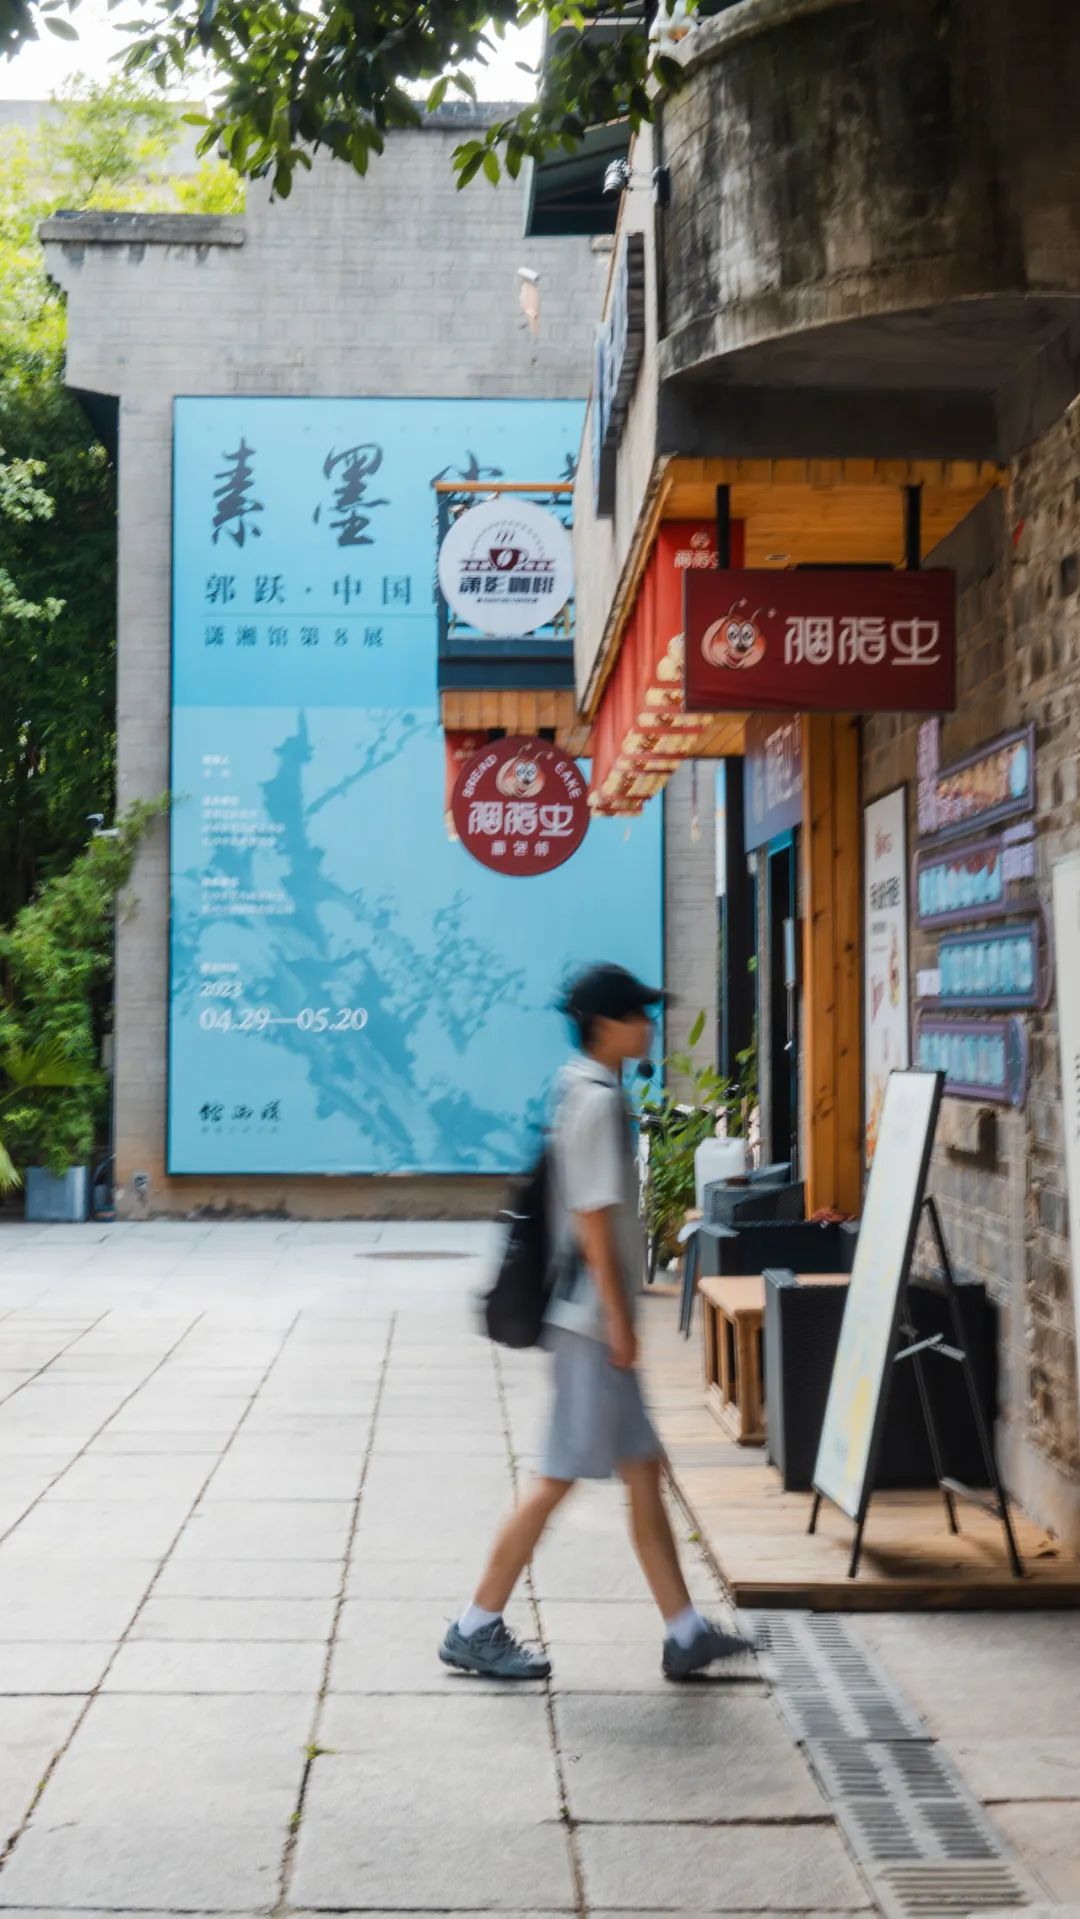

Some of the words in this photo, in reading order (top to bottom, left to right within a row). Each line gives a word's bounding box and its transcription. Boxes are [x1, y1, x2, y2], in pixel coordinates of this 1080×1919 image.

[784, 616, 942, 666] 胭脂虫
[554, 760, 583, 800] CAKE
[468, 801, 574, 837] 胭脂虫
[200, 981, 243, 999] 2023
